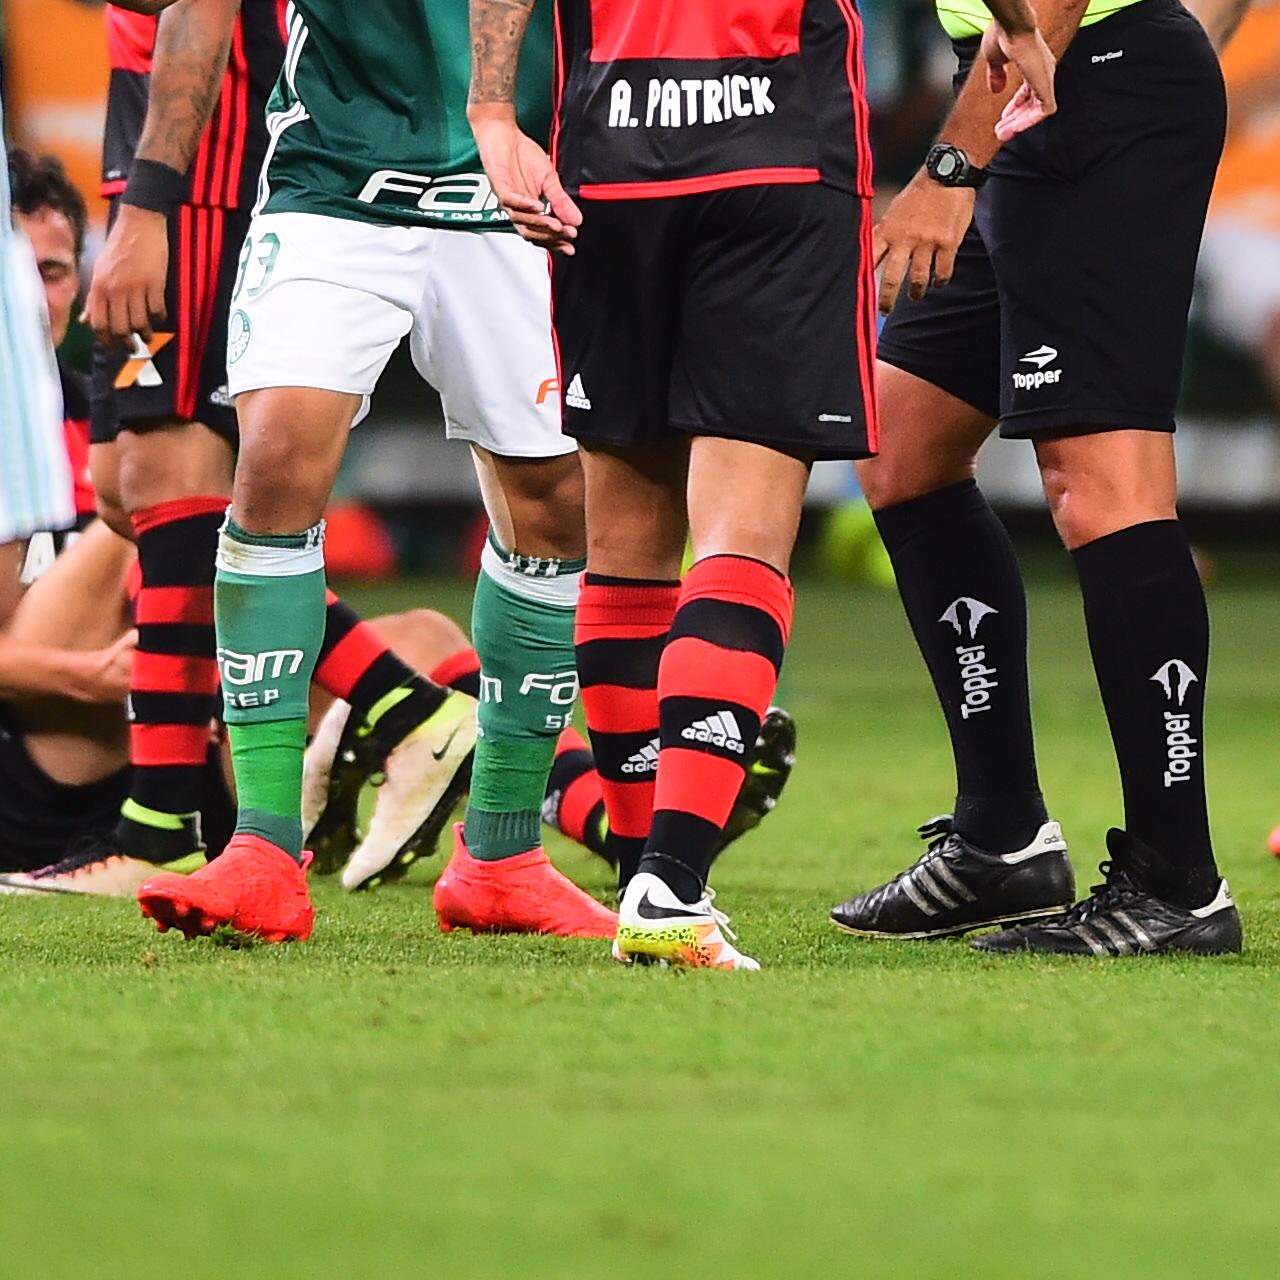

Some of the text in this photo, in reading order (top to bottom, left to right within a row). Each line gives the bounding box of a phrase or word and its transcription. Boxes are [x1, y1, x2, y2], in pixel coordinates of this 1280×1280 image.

[608, 74, 775, 128] A. PATRICK
[1012, 367, 1063, 391] Topper
[960, 644, 999, 719] Topper
[680, 726, 745, 755] adidas
[1164, 711, 1198, 787] Topper
